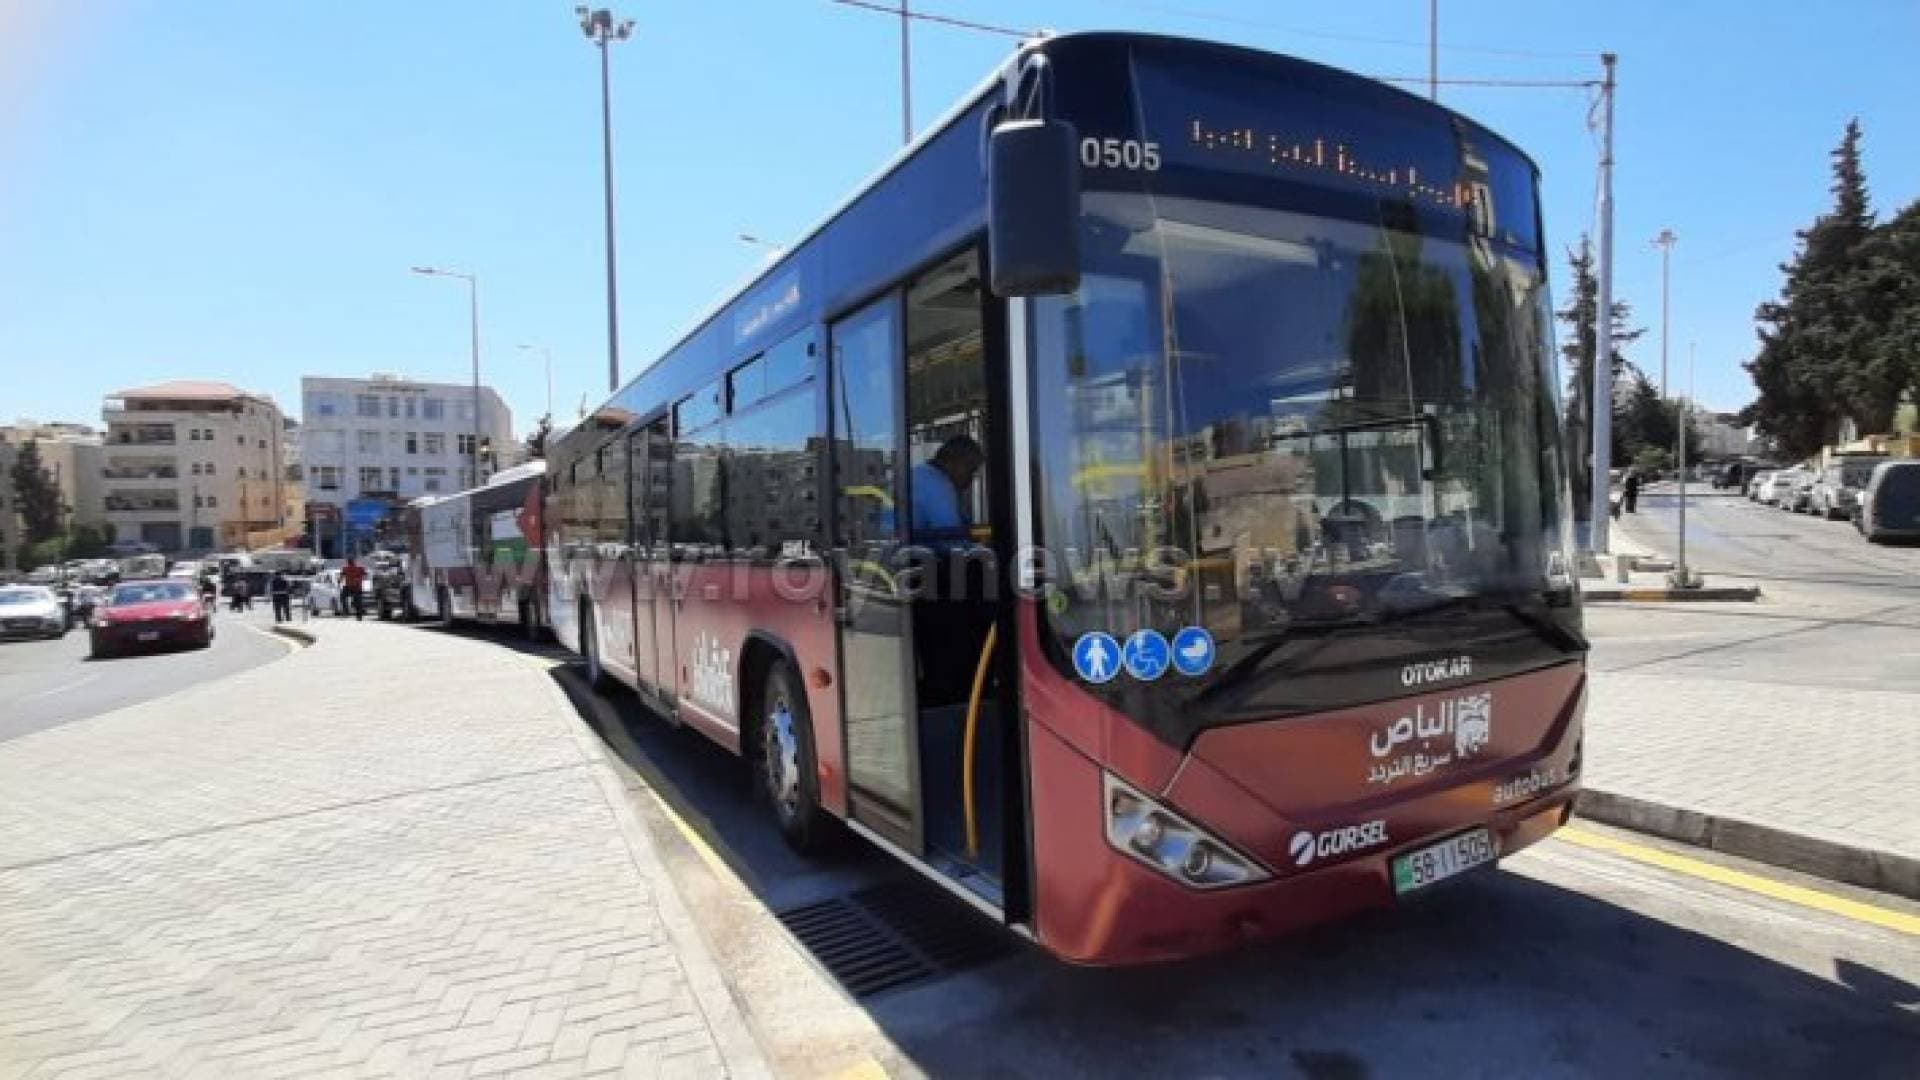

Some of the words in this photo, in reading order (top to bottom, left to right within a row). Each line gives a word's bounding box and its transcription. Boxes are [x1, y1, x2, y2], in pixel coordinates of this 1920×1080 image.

[1081, 138, 1162, 171] 0505
[1401, 656, 1471, 687] OTOKAR
[1371, 700, 1454, 757] الباص
